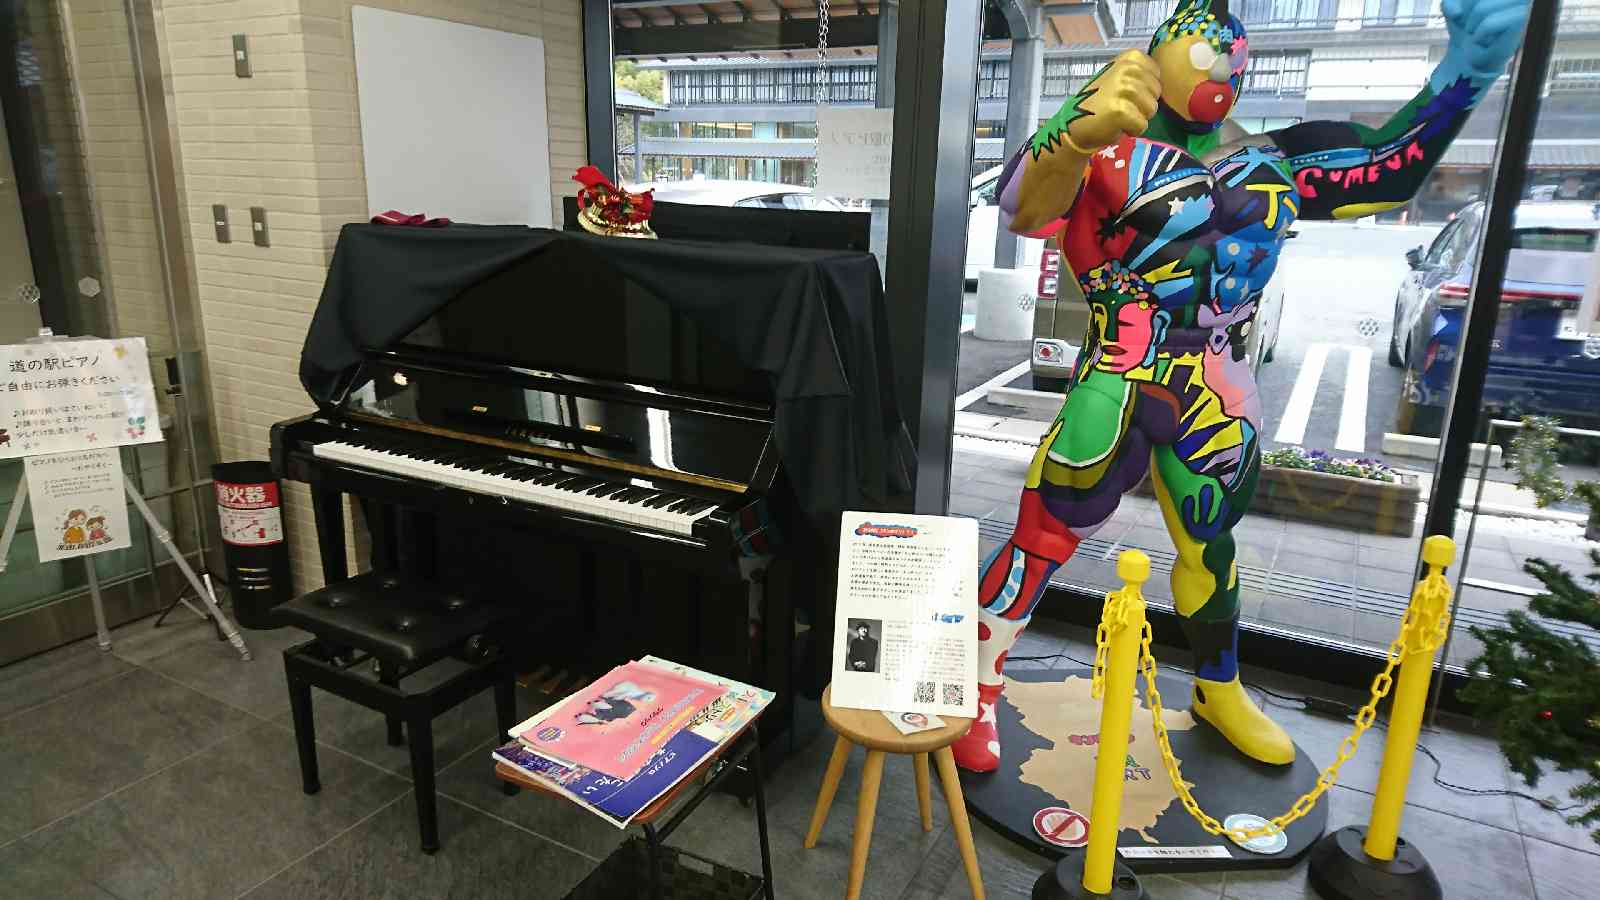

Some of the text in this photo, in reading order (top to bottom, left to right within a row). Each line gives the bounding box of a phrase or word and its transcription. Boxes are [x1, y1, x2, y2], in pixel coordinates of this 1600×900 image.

[9, 355, 99, 373] 道の駅ピアノ
[217, 484, 266, 503] 消火器
[1124, 767, 1152, 781] RT
